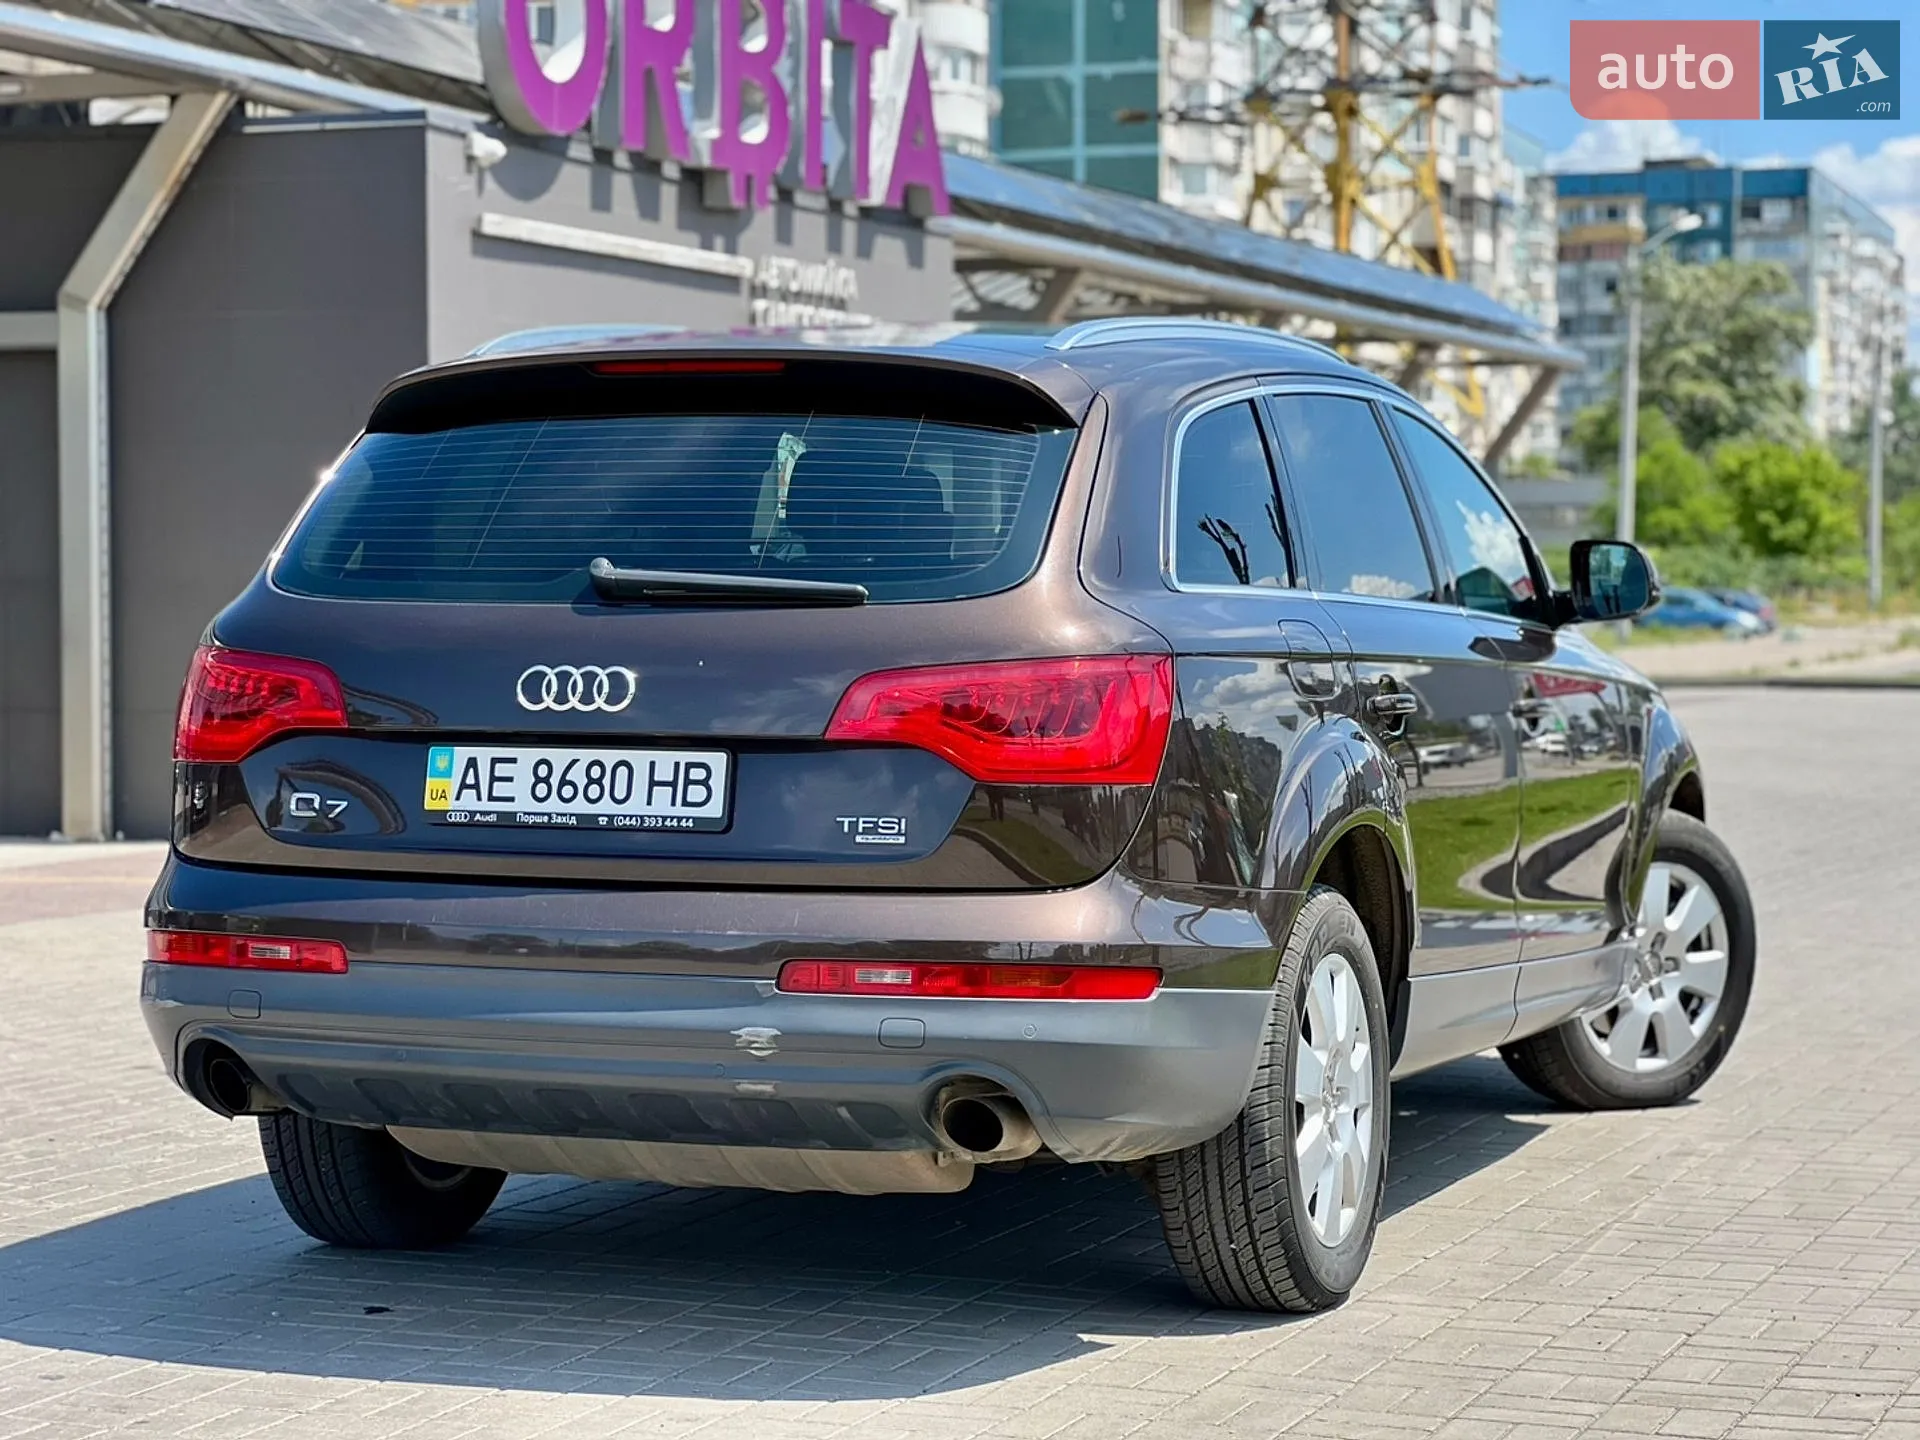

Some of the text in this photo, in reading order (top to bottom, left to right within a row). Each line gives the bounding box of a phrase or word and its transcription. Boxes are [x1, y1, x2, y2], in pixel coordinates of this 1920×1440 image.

[480, 0, 950, 216] ORBITA
[455, 756, 713, 809] AE 8680 HB
[290, 792, 349, 818] Q7
[429, 789, 448, 802] UA
[474, 812, 694, 828] Audi Порше Захід (044) 393 44 44
[835, 817, 906, 834] TFSI
